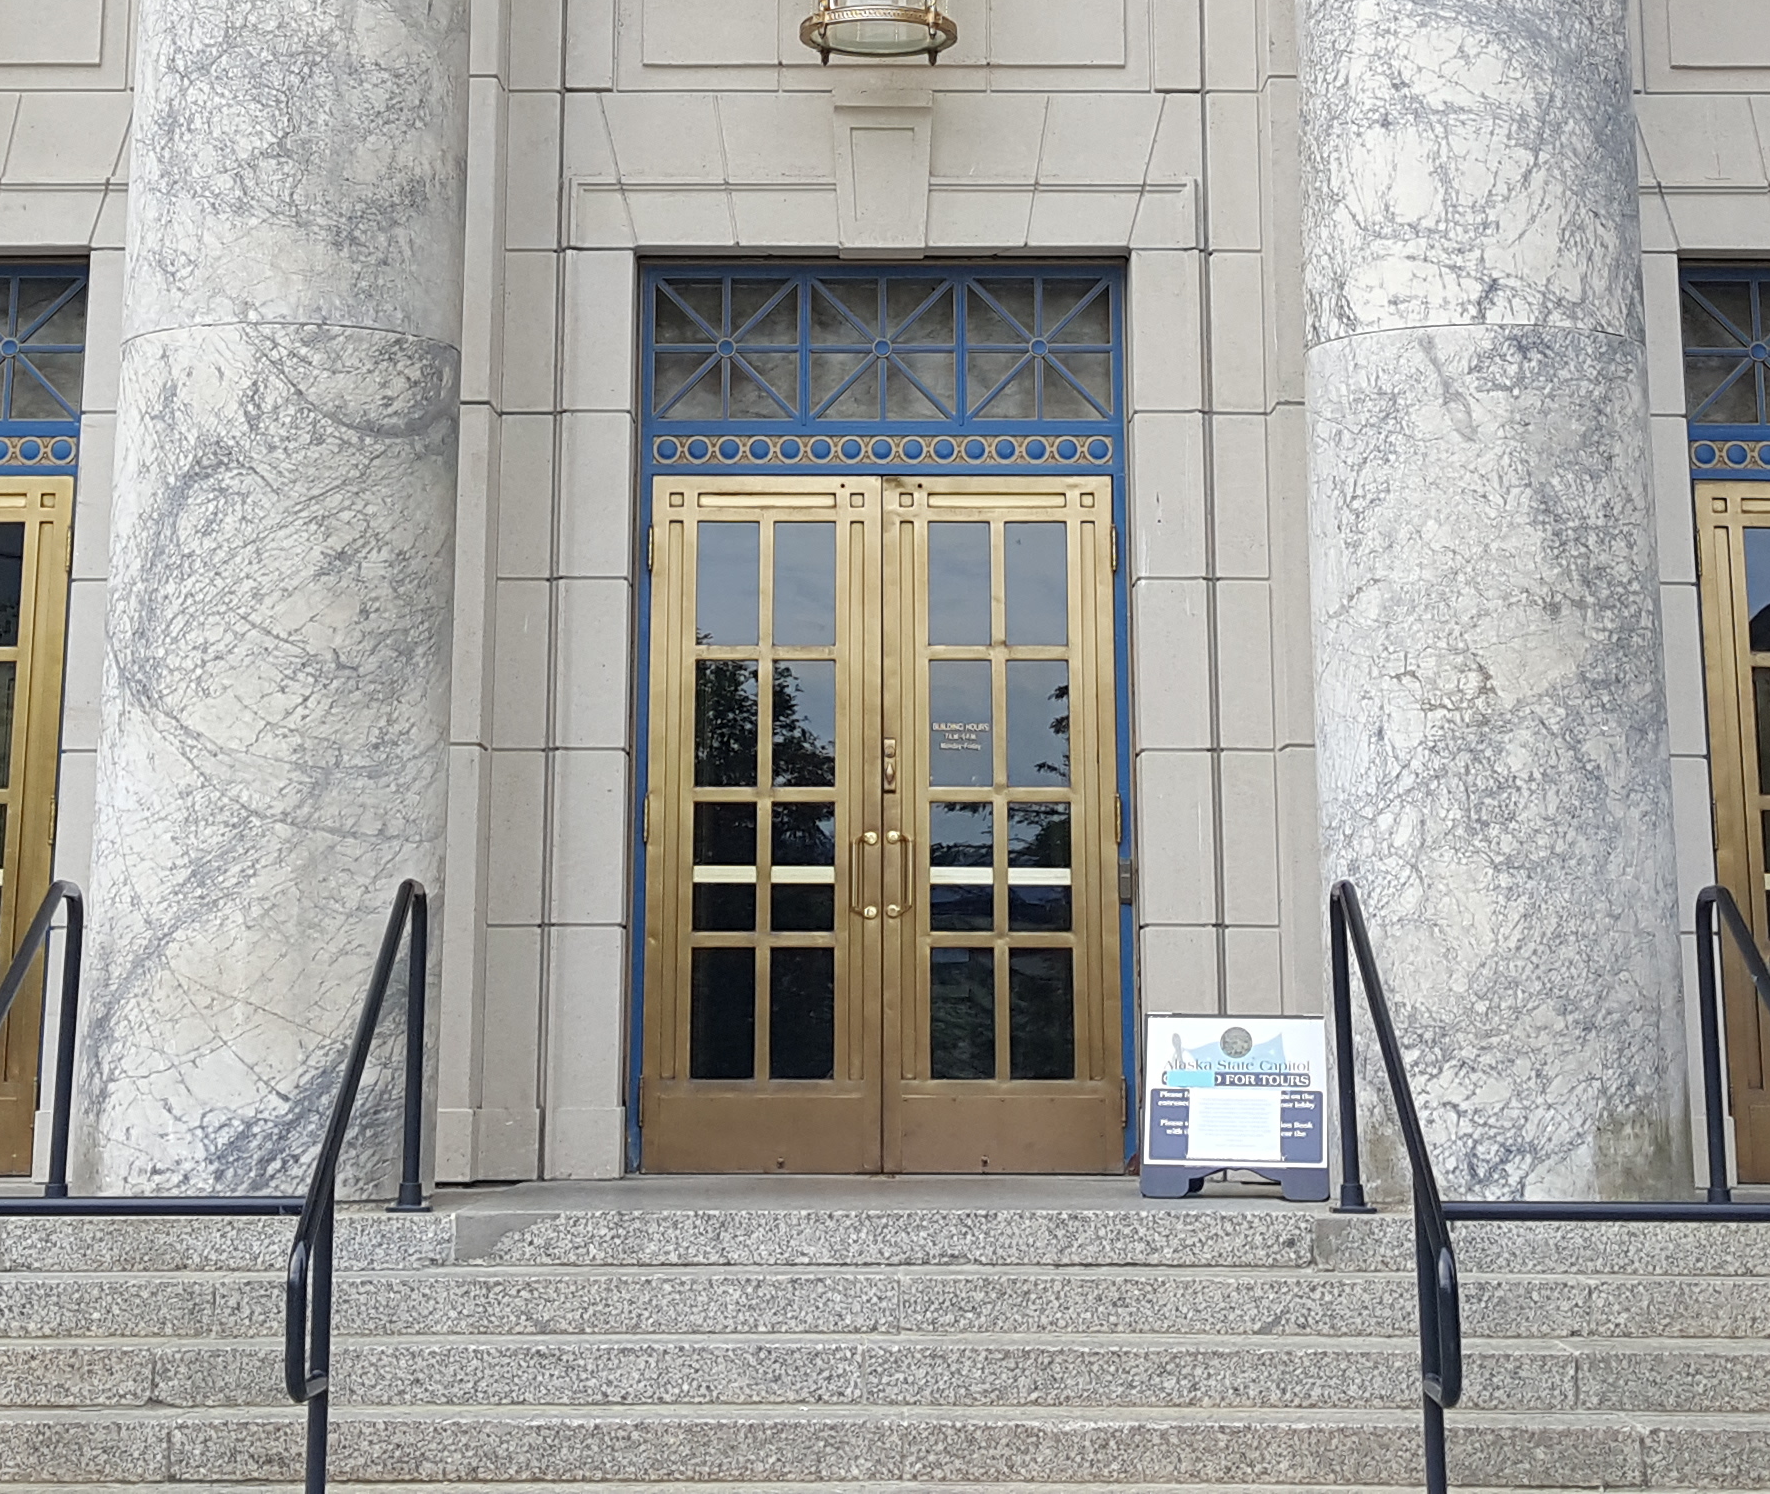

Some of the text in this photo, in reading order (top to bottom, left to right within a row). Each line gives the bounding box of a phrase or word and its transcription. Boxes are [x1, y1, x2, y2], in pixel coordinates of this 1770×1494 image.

[932, 722, 989, 731] BUILDING HOURS
[1164, 1059, 1310, 1073] Alaska State Capitol
[1225, 1074, 1256, 1085] FOR
[1260, 1075, 1310, 1086] TOURS
[1295, 1101, 1315, 1109] lobby
